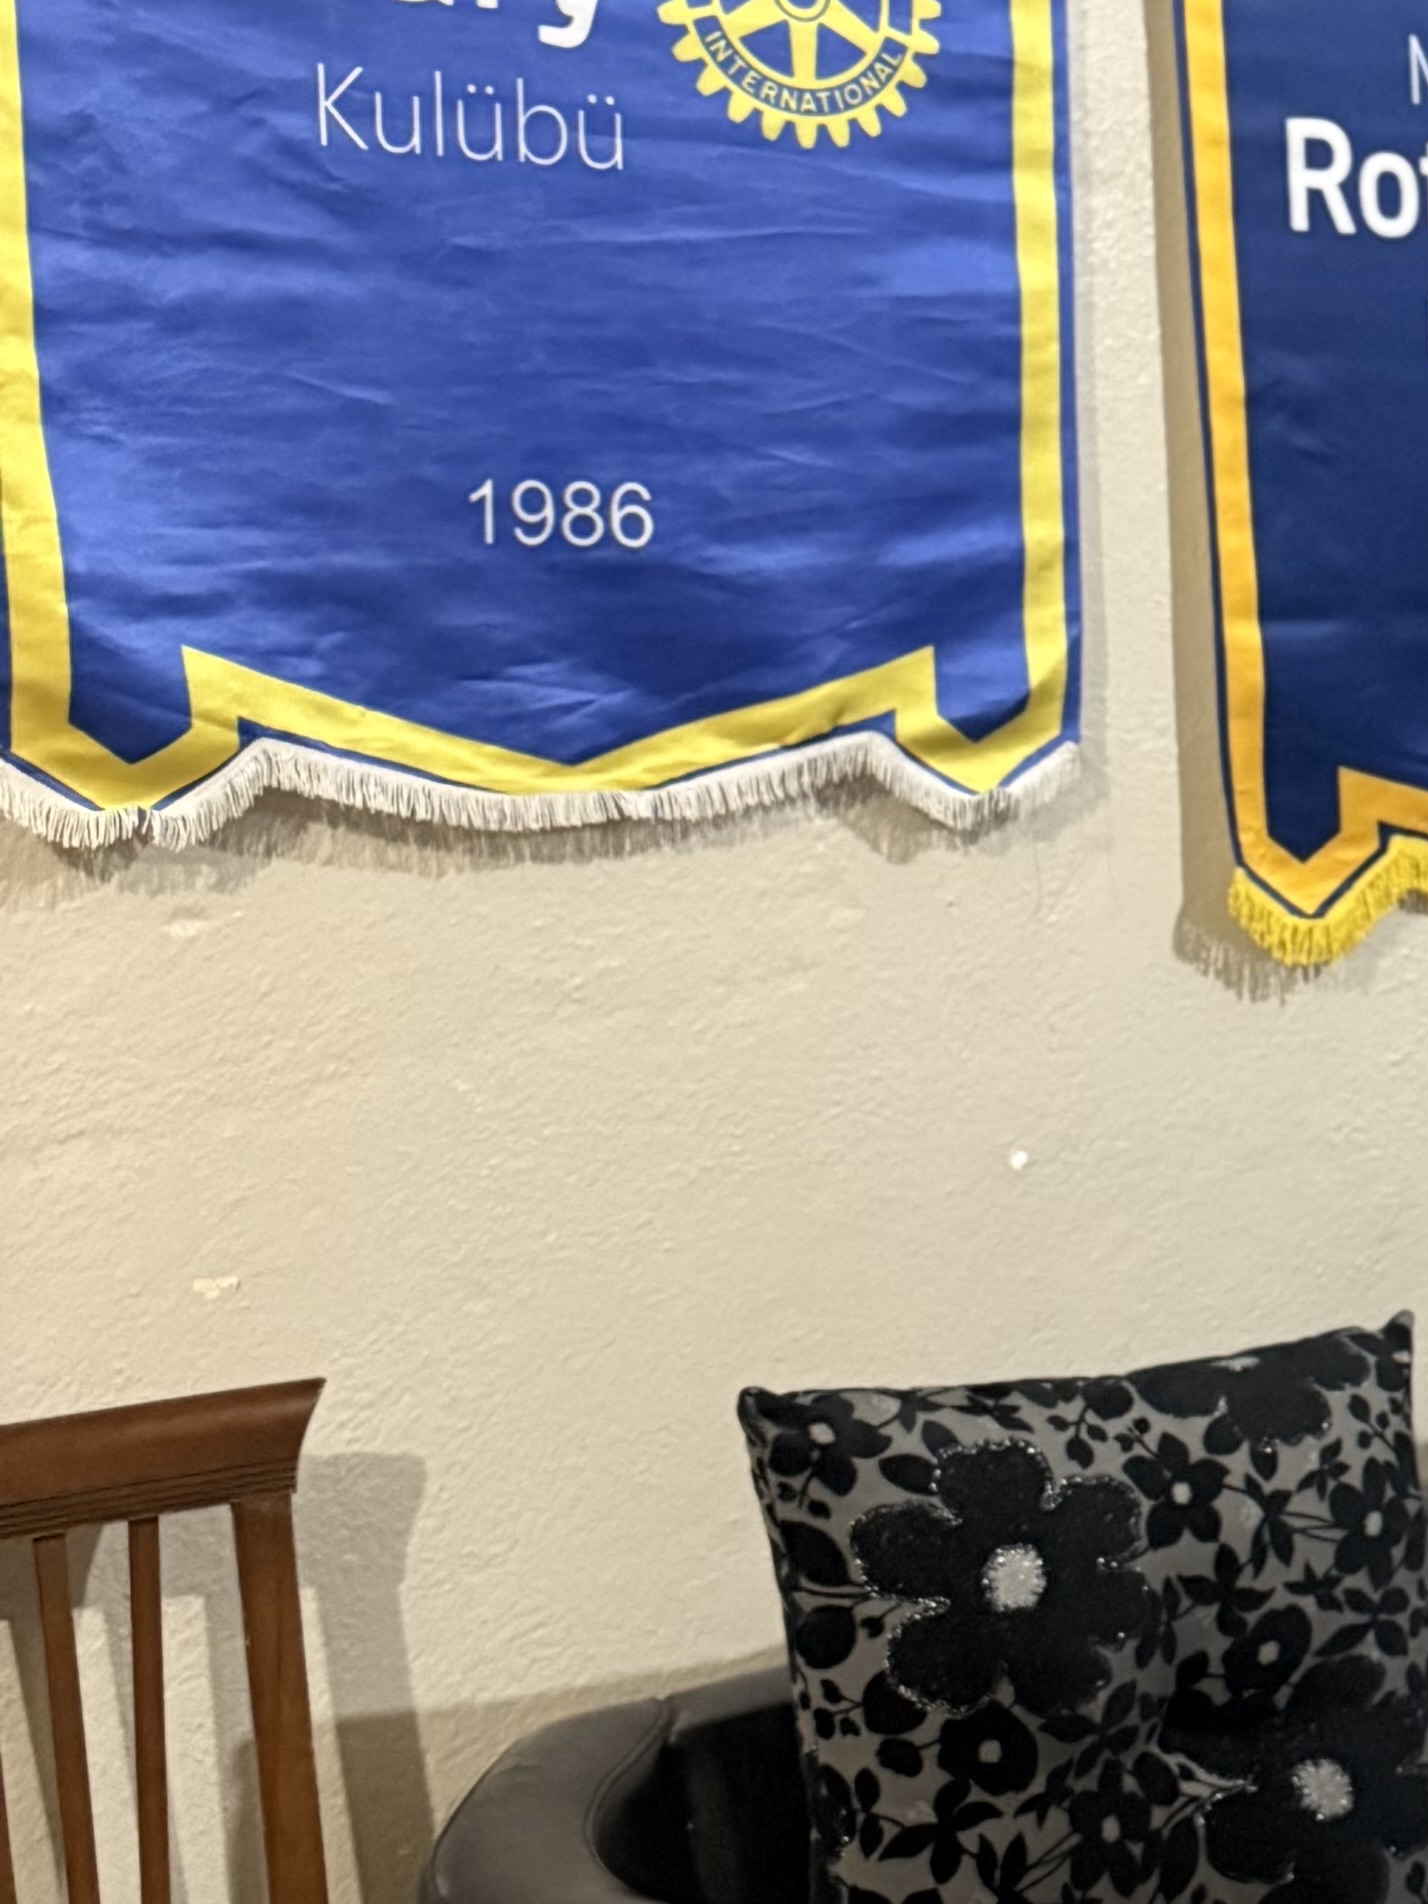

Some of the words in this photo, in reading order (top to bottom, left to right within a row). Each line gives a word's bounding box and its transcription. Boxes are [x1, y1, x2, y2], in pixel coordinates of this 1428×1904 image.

[704, 31, 901, 112] INTERNATIONAL
[316, 61, 624, 171] Kulübü
[468, 478, 655, 550] 1986
